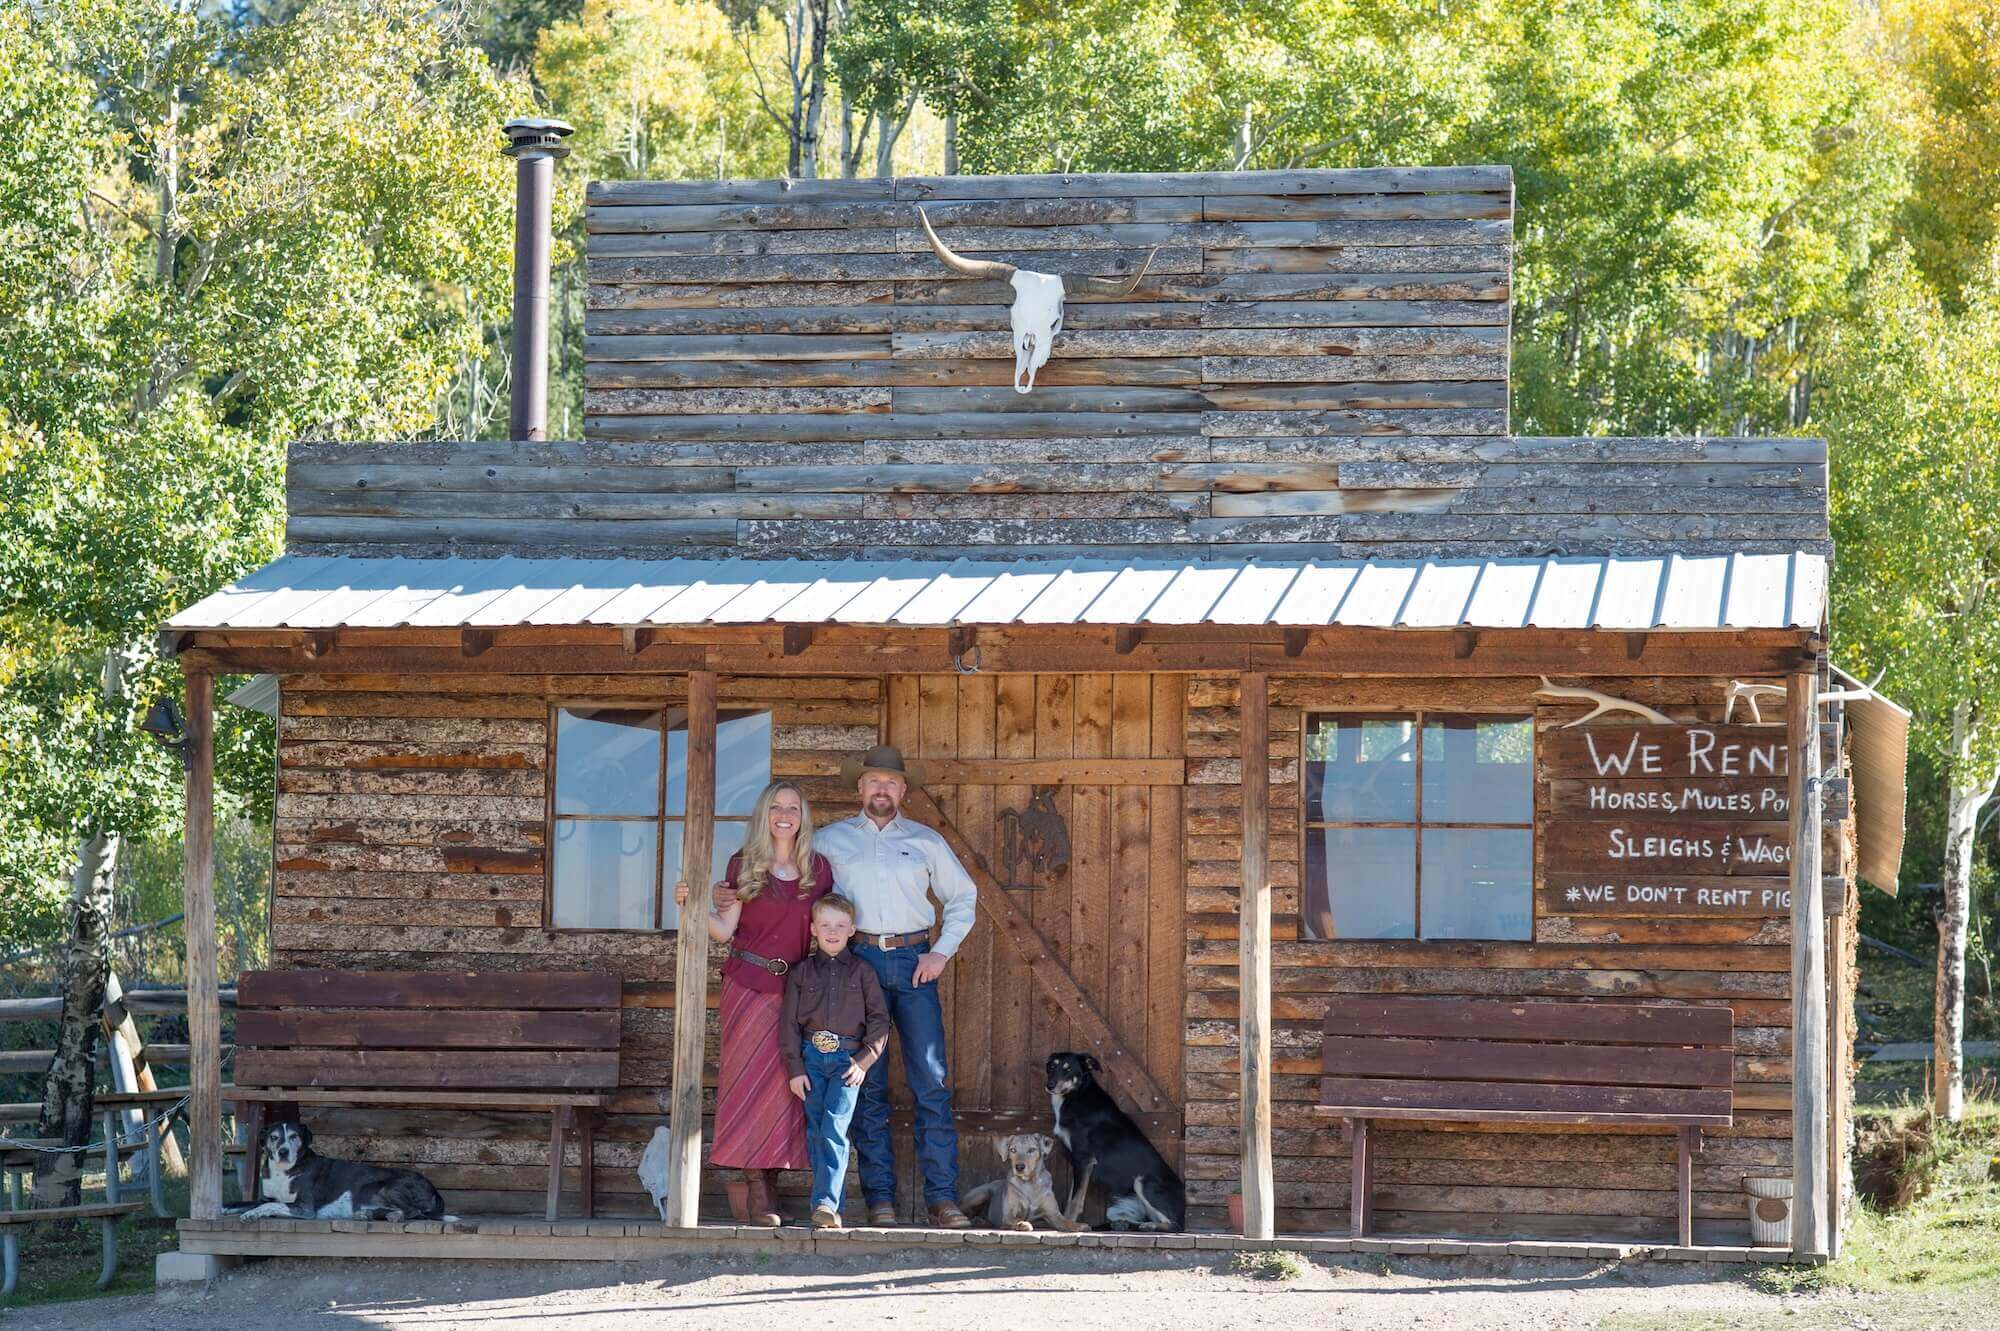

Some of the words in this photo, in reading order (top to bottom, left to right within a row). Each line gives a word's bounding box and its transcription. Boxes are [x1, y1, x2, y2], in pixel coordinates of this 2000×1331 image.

[1586, 731, 1663, 777] WE
[1685, 728, 1789, 777] RENT
[1590, 786, 1678, 814] HORSES,
[1681, 787, 1755, 814] MULES,
[1608, 827, 1714, 858] SLEIGHS
[1627, 885, 1688, 905] DON'T
[1697, 888, 1752, 906] RENT
